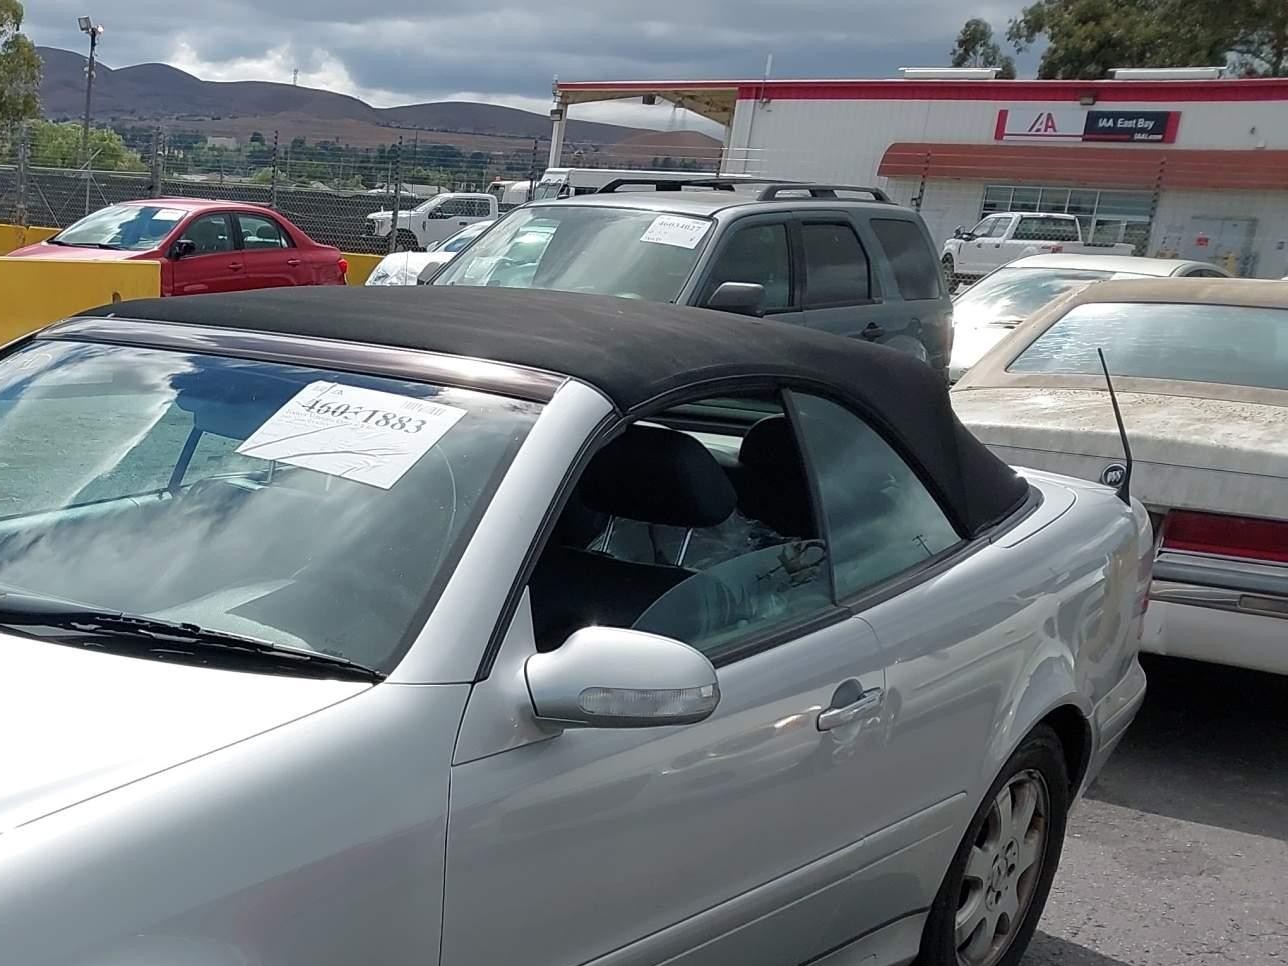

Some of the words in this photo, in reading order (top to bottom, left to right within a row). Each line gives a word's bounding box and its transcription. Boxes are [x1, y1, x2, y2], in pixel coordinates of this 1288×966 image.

[1098, 118, 1114, 128] IAA
[1117, 118, 1136, 128] East
[1137, 118, 1155, 130] Bay
